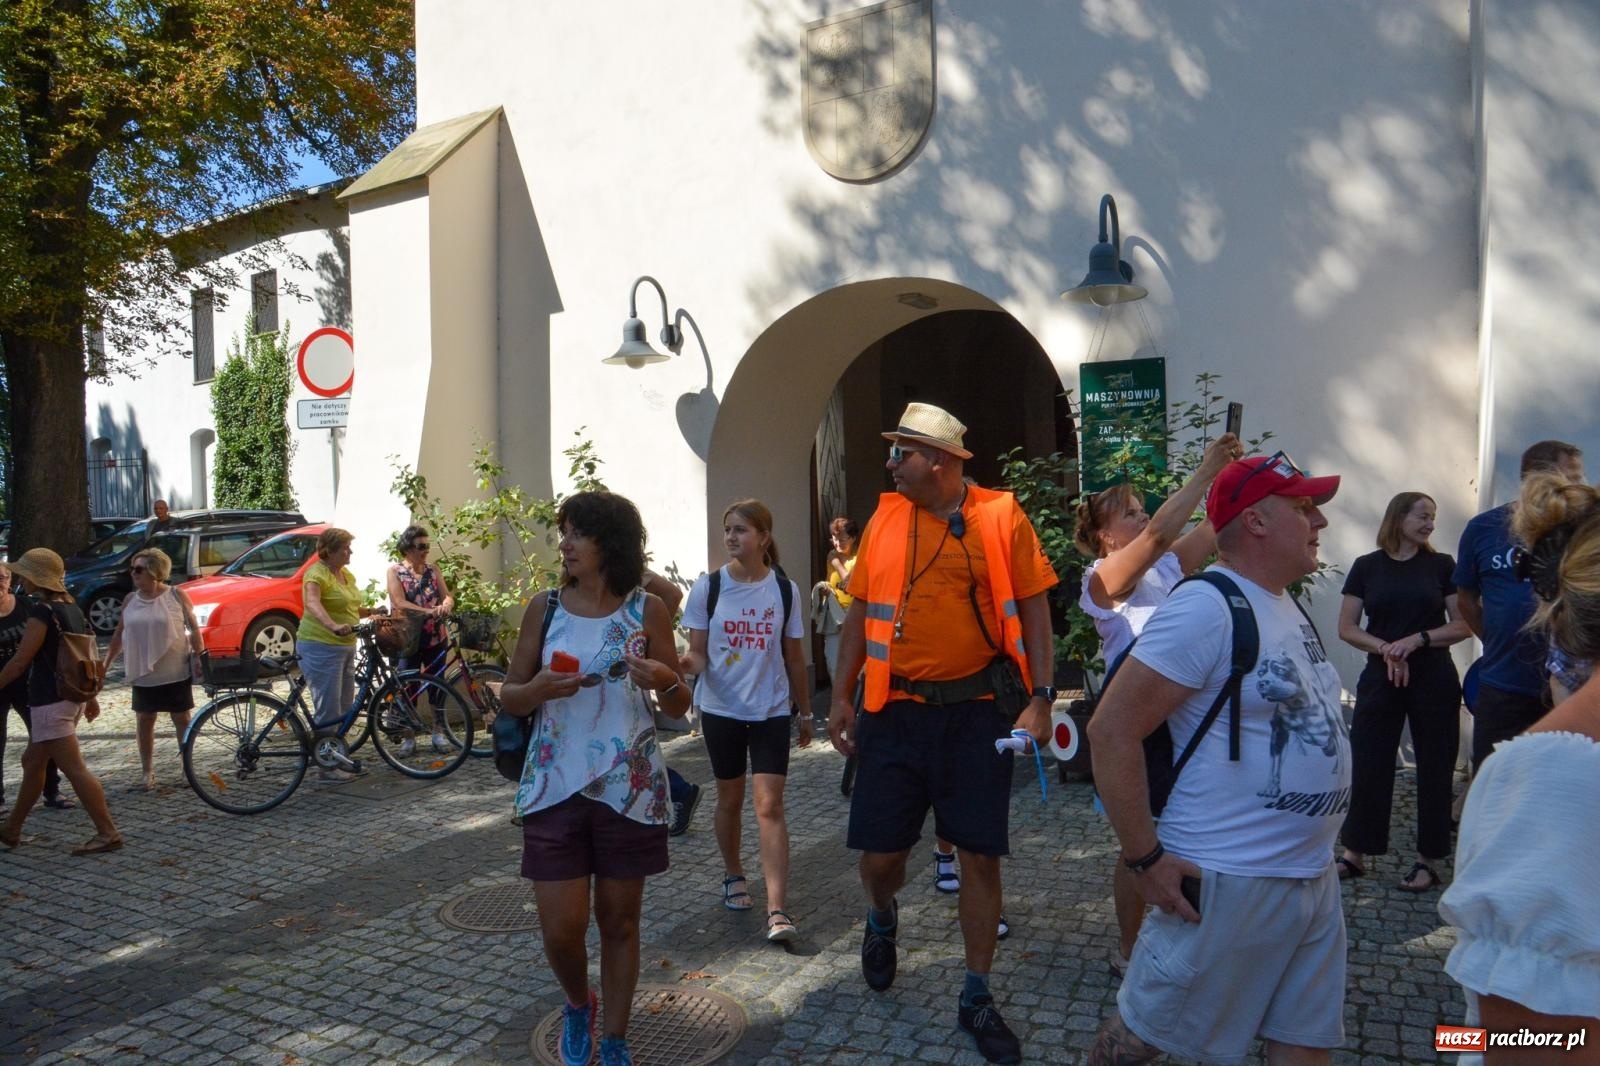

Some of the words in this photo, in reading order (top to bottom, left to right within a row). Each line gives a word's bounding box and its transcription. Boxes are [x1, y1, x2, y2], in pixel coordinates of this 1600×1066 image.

[1086, 389, 1160, 402] MASZYNOWNIA
[742, 608, 756, 616] LA
[724, 621, 773, 635] DOLCE
[1264, 786, 1350, 817] SURVIVA
